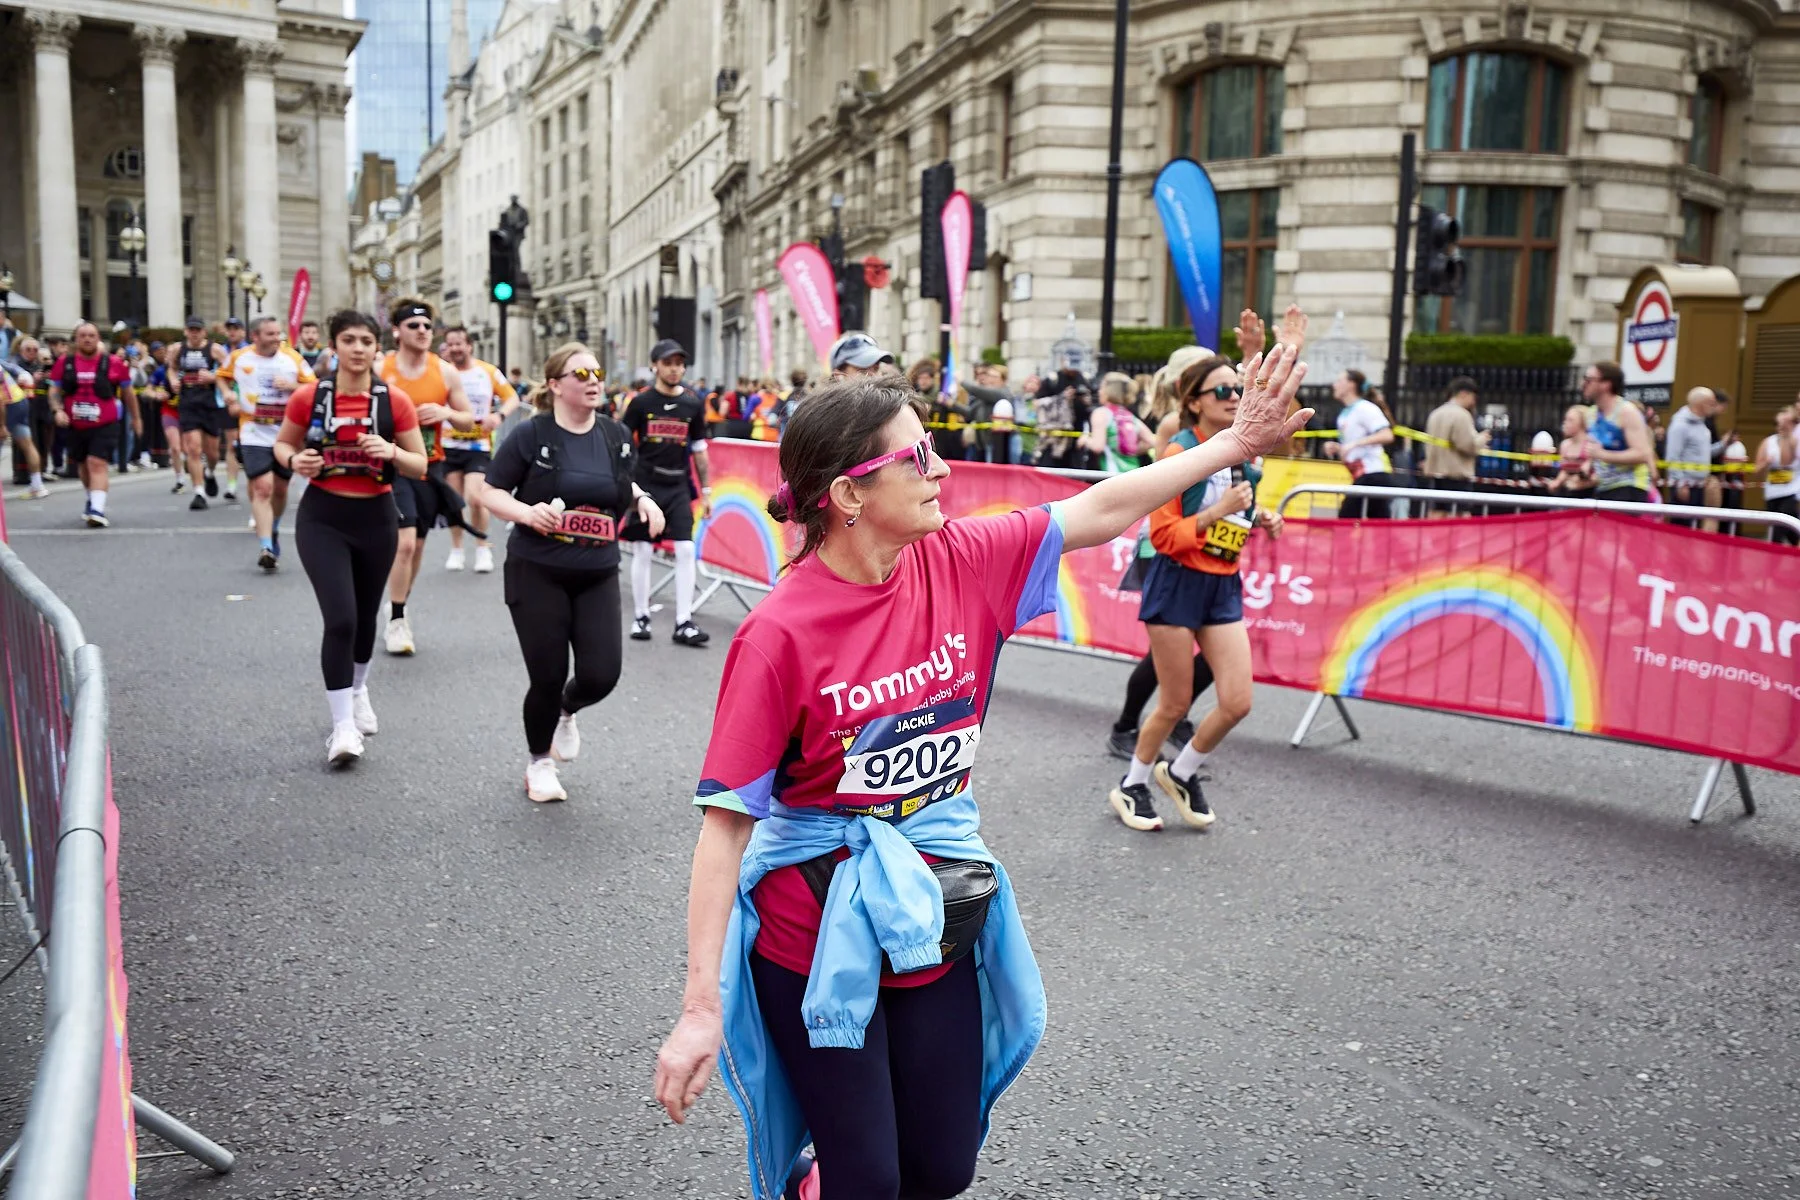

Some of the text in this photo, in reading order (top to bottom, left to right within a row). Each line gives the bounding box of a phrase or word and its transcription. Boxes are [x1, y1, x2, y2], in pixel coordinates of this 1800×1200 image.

[561, 514, 610, 536] 16851
[820, 632, 967, 716] Tommy's
[1632, 646, 1668, 667] The
[1670, 655, 1771, 691] pregnancy
[929, 687, 952, 705] baby
[894, 712, 936, 733] JACKIE
[829, 729, 851, 739] The
[864, 735, 961, 790] 9202
